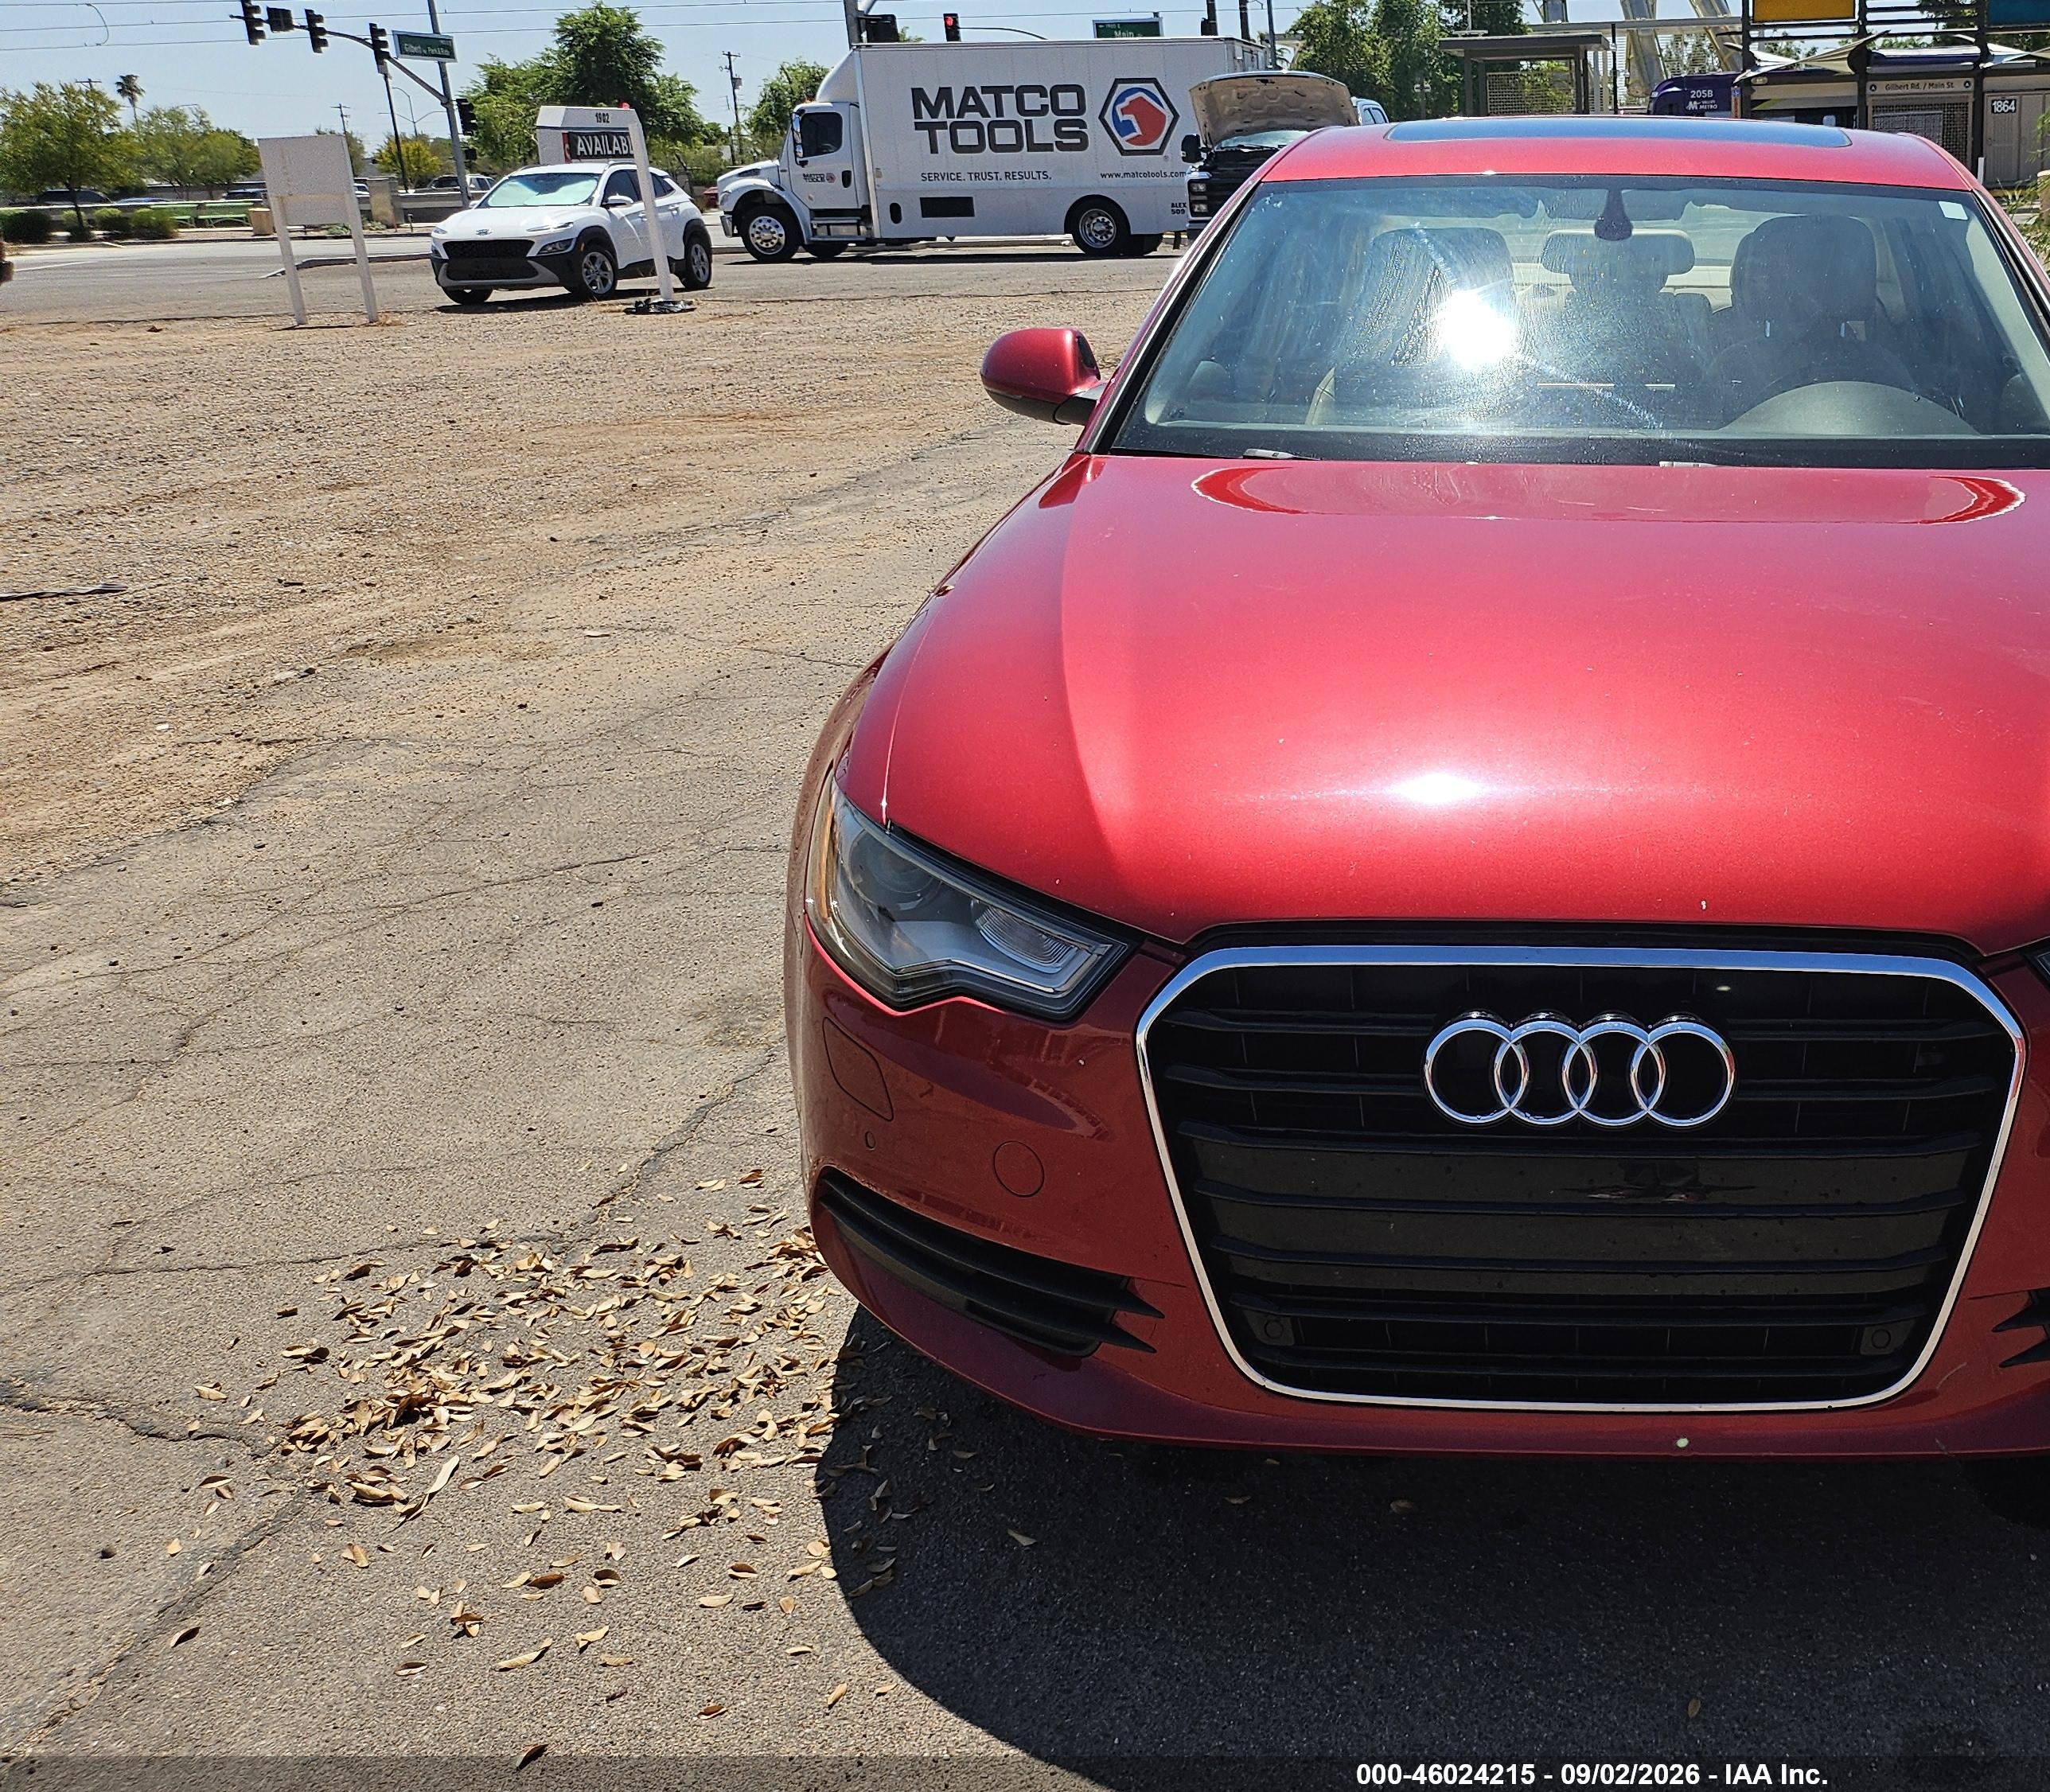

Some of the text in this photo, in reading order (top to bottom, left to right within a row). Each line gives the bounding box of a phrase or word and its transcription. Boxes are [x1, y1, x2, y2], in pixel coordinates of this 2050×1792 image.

[1690, 90, 1713, 99] 205B
[911, 84, 1086, 119] MATCO
[1992, 100, 2016, 112] 1864
[914, 119, 1089, 154] TOOLS
[921, 170, 1052, 182] SERVICE. TRUST. RESULTS.
[1101, 170, 1187, 179] www.matcotools.com
